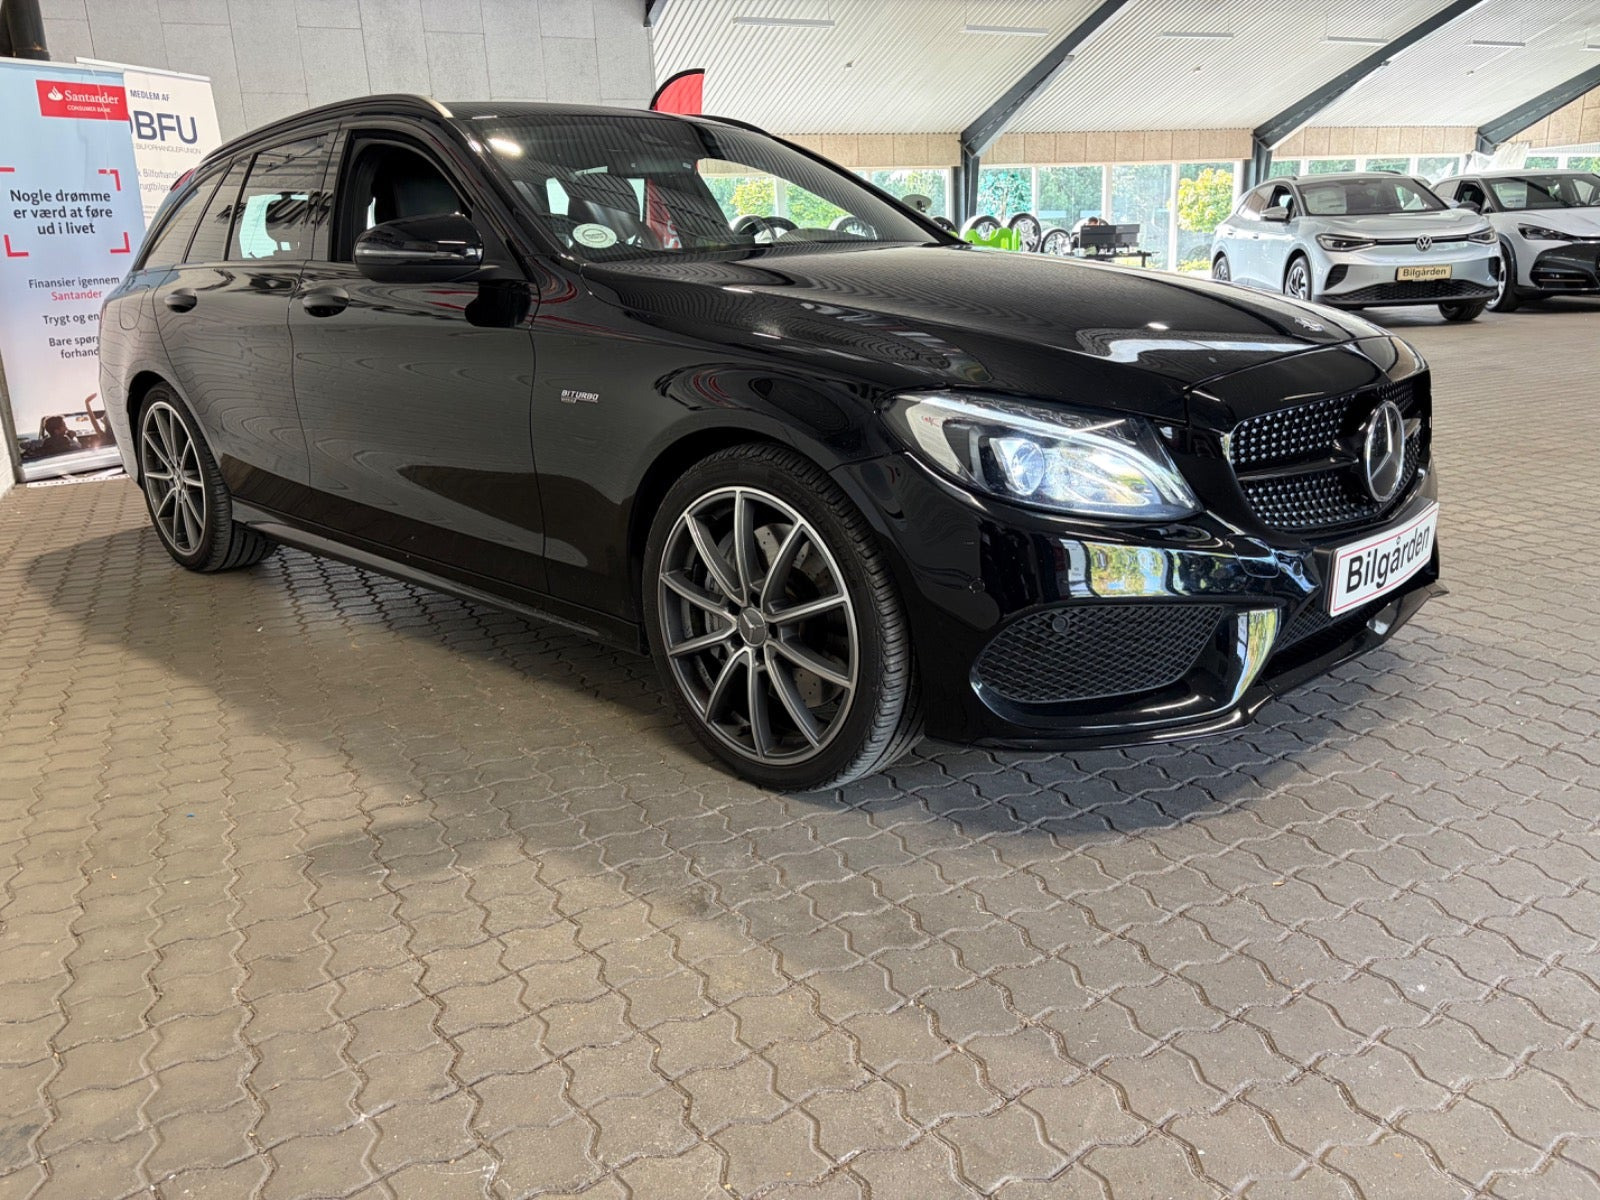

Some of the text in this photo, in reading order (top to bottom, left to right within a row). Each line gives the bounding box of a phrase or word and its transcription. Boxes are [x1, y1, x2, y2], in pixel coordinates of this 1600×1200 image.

[65, 89, 119, 105] Santander
[130, 89, 170, 101] MEDLEM AF
[67, 104, 96, 112] CONSUMER
[130, 110, 198, 144] BFU
[10, 189, 111, 206] Nogle drømme
[13, 206, 113, 219] er værd at føre
[38, 222, 55, 235] ud
[66, 222, 96, 235] livet
[1403, 267, 1446, 278] Bilgården
[29, 276, 120, 289] Finansier igennem
[51, 290, 102, 301] Santander
[42, 314, 71, 326] Trygt
[72, 315, 86, 325] og
[49, 337, 72, 347] Bare
[562, 390, 599, 400] BITURBO
[1345, 526, 1430, 594] Bilgården
